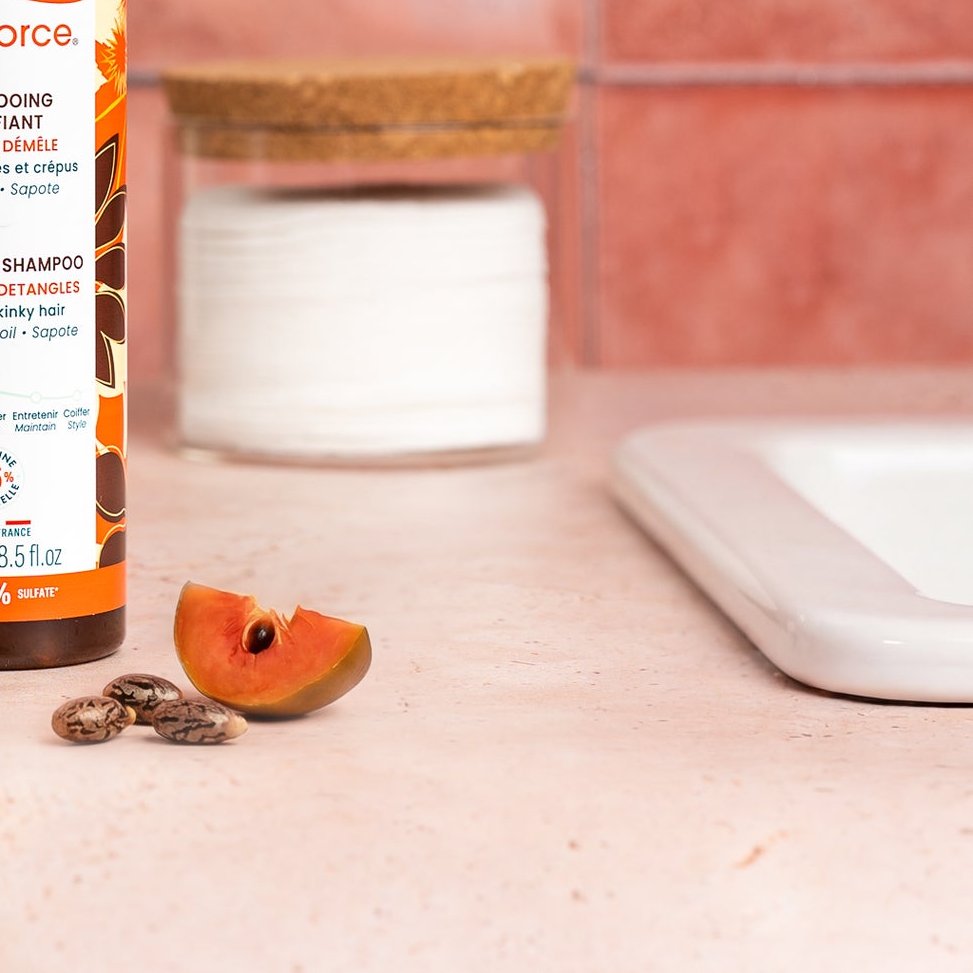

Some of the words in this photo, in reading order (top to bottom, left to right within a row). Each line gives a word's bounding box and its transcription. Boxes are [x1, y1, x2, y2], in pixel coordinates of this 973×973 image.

[3, 136, 58, 153] DÉMÊLE
[15, 161, 29, 174] et
[33, 159, 78, 177] crépus
[10, 182, 60, 198] Sapote
[2, 255, 84, 272] SHAMPOO
[39, 303, 65, 317] hair
[0, 326, 17, 340] oil
[32, 324, 79, 342] Sapote
[12, 410, 59, 421] Entretenir
[63, 407, 90, 418] Coiffer
[14, 422, 57, 432] Maintain
[67, 420, 87, 432] Style
[30, 544, 62, 566] fl.oz
